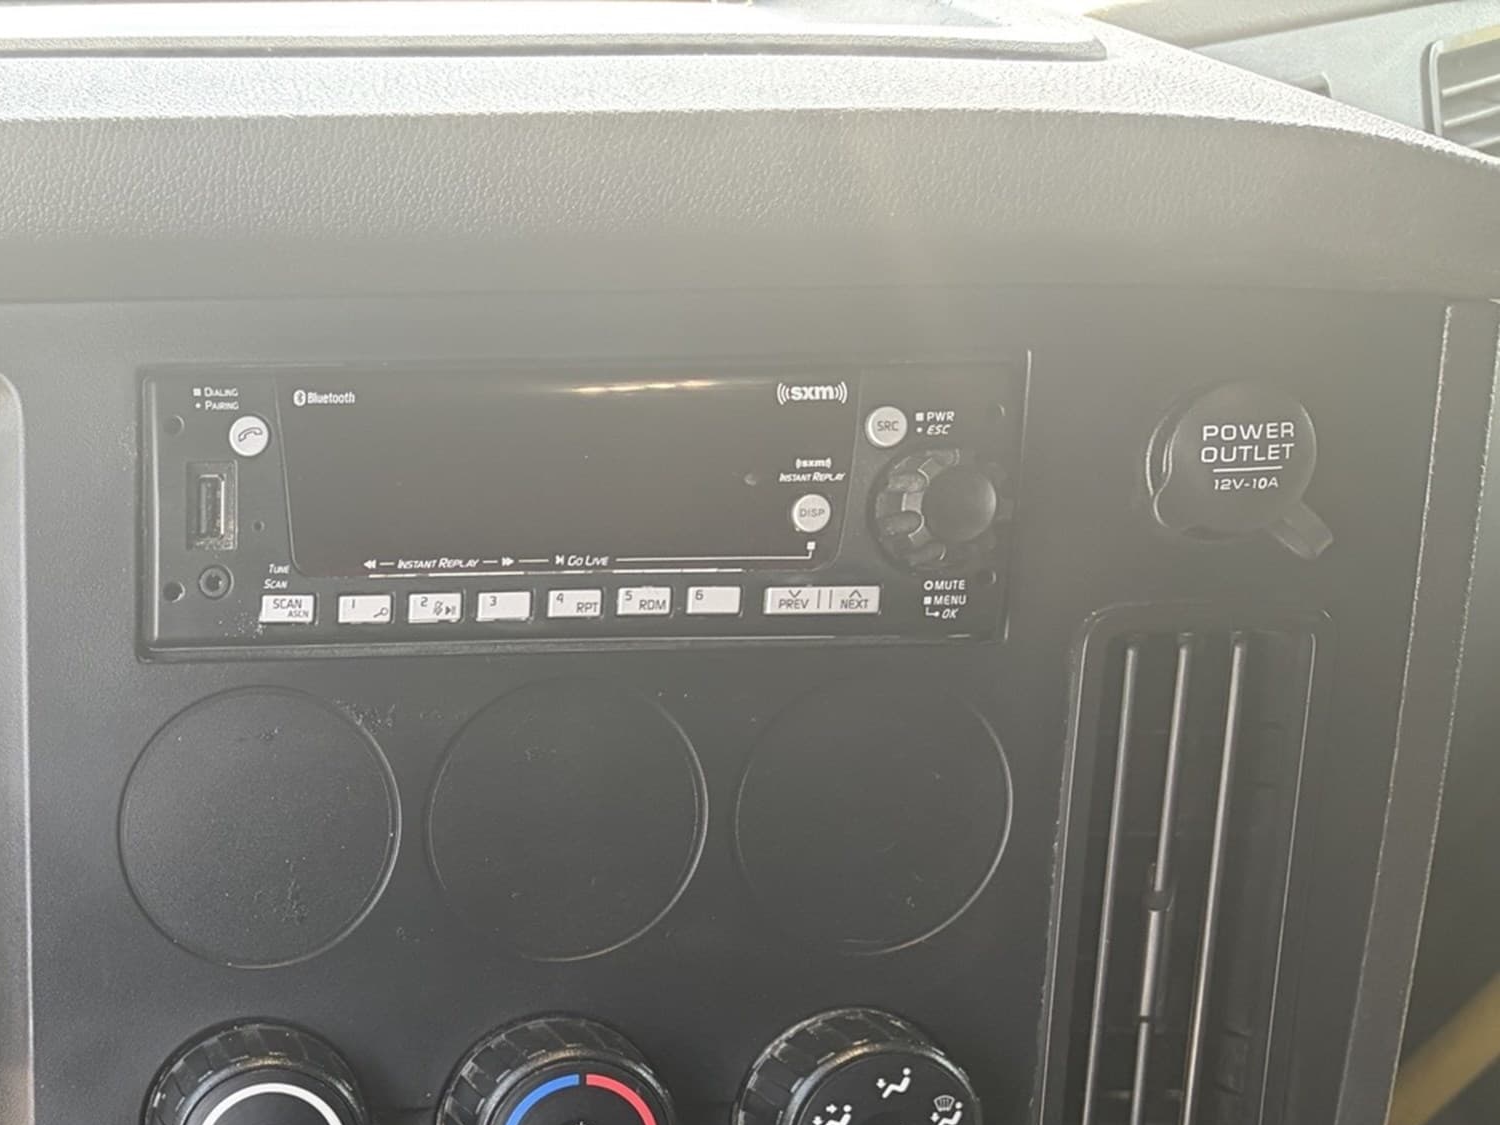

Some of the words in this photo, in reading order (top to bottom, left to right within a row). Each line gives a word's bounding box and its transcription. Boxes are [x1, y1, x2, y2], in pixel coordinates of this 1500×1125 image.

[307, 392, 356, 404] Bluetooth
[927, 411, 955, 422] PWR
[877, 421, 899, 432] SRC
[927, 424, 951, 435] ESC
[1202, 421, 1295, 441] POWER
[1201, 443, 1295, 463] OUTLET
[1213, 477, 1279, 490] 12V-10A
[799, 508, 825, 518] DISP
[935, 580, 966, 590] MUTE
[555, 593, 564, 603] 4
[625, 591, 633, 601] 5
[695, 589, 703, 600] 6
[934, 595, 967, 605] MENU
[273, 598, 302, 609] SCAN
[420, 597, 428, 607] 2
[489, 596, 498, 606] 3
[639, 600, 666, 611] RDM
[778, 599, 810, 609] PREV
[840, 599, 869, 609] NEXT
[576, 602, 599, 613] RPT
[941, 609, 959, 619] OK
